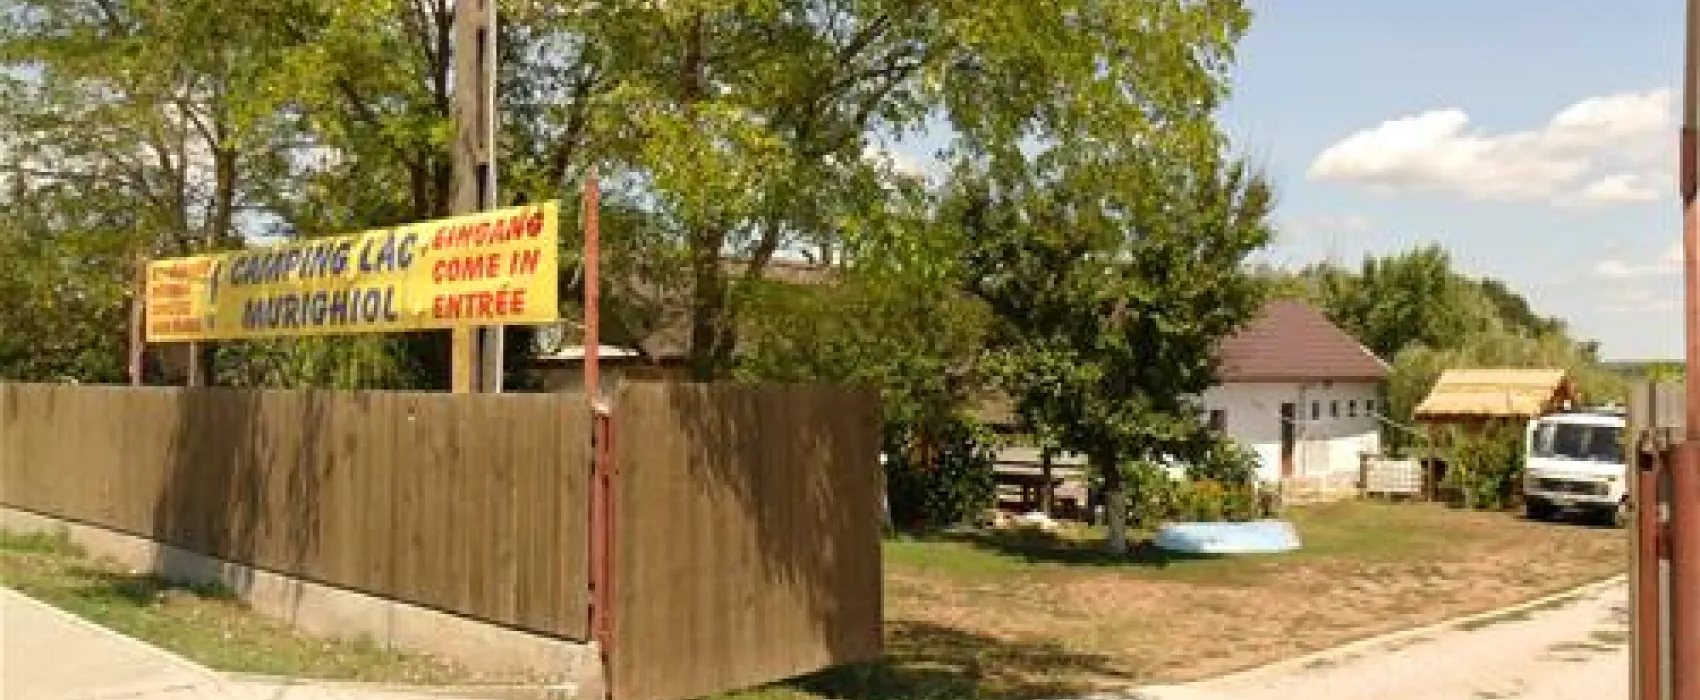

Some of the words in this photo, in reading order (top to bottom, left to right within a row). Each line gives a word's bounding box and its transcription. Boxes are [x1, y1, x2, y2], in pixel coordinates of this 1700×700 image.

[230, 242, 349, 286] CAMPING
[359, 232, 418, 274] LAC
[432, 253, 500, 284] COME
[509, 249, 541, 275] IN
[241, 285, 398, 329] MURIGHIOL
